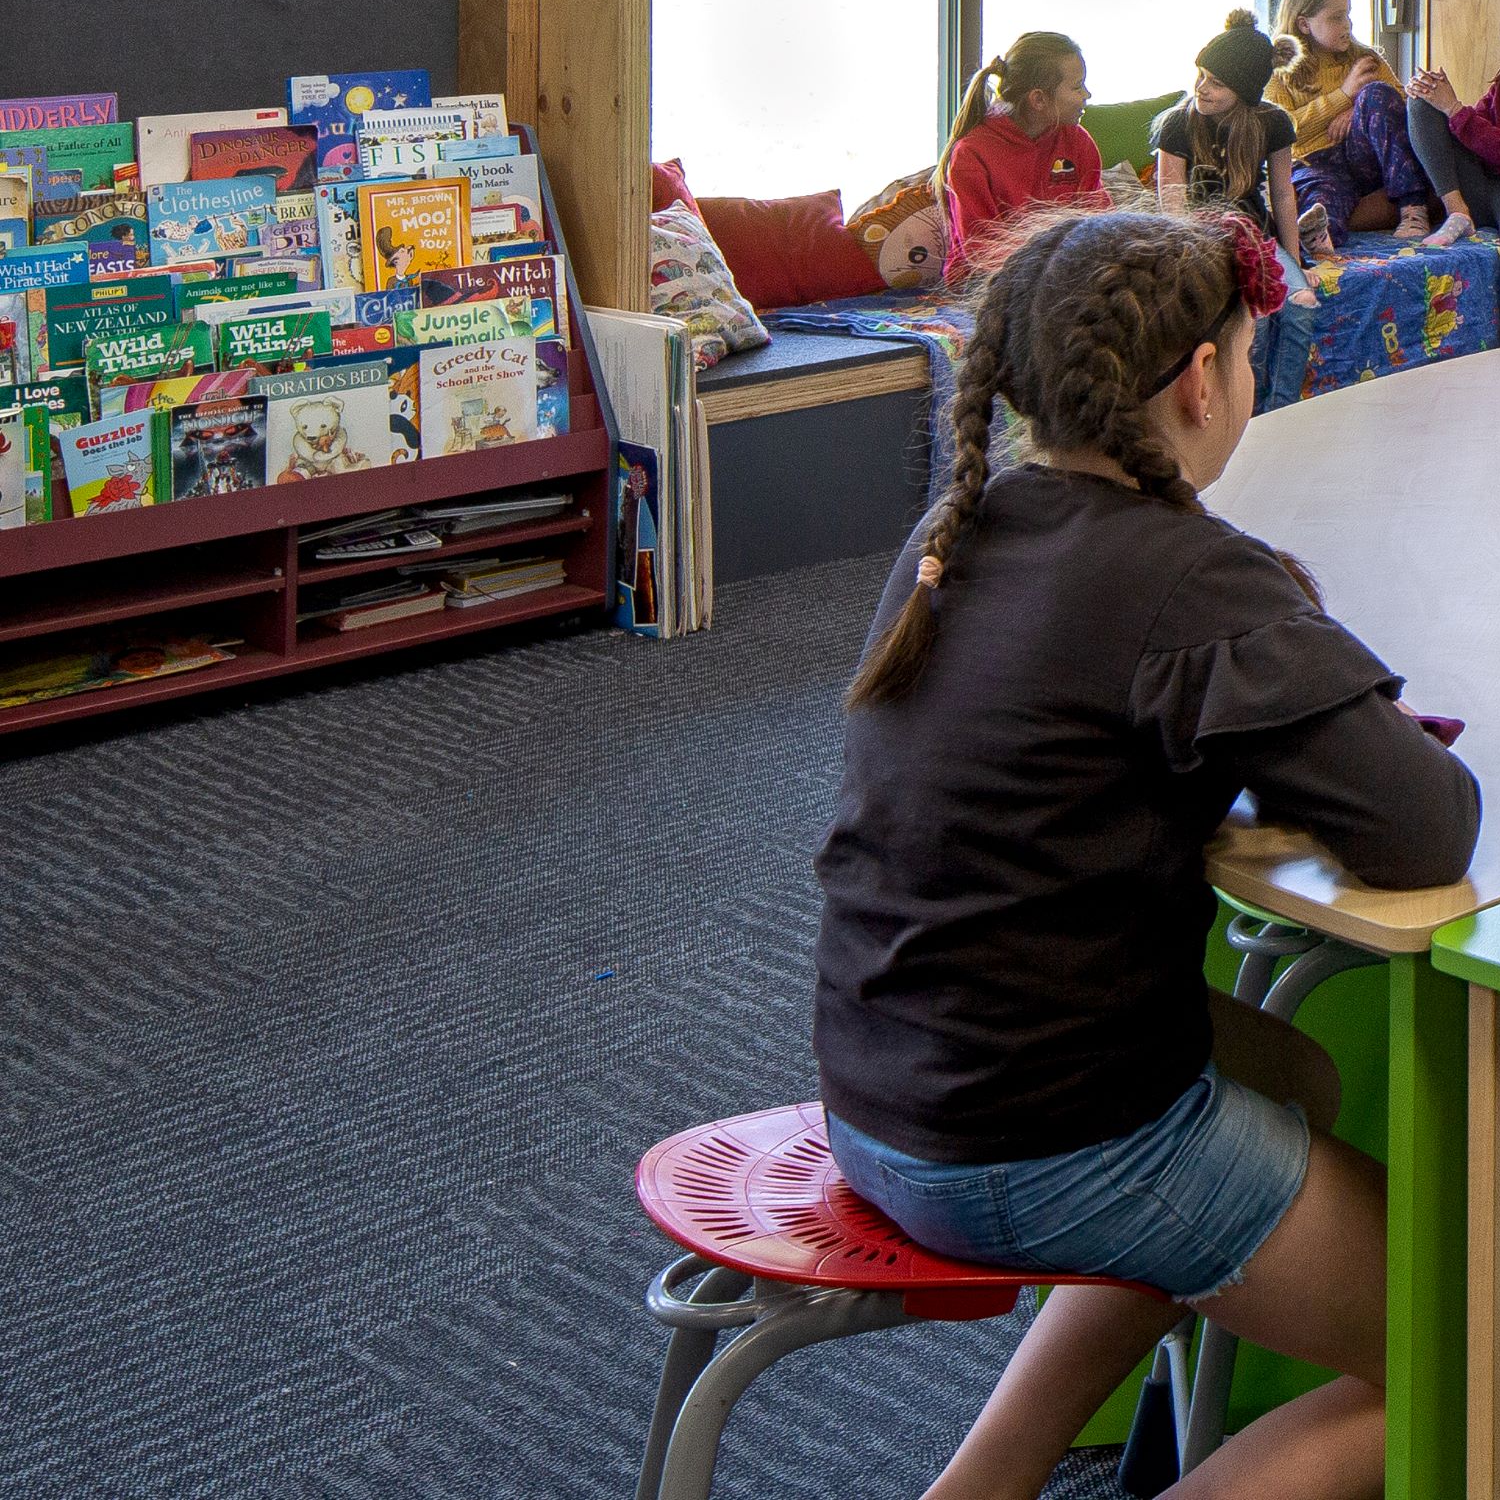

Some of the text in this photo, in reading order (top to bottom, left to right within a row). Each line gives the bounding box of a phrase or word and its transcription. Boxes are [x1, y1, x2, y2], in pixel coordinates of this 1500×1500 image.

[479, 100, 499, 110] Likes
[58, 137, 122, 152] Father of All
[199, 132, 281, 160] DINOSAUR
[238, 139, 309, 164] DANGER
[458, 163, 514, 180] My book
[175, 186, 193, 196] The
[485, 179, 510, 187] Maris
[158, 183, 265, 216] Clothesline
[386, 192, 453, 208] MR. BROWN
[63, 202, 117, 236] GOING
[391, 206, 415, 218] CAN
[401, 207, 453, 232] MOO!
[423, 228, 448, 238] CAN
[419, 237, 453, 251] YOU?
[0, 263, 32, 277] Wish
[43, 258, 72, 272] Had
[454, 260, 551, 290] The Witch
[4, 272, 69, 290] Pirate Suit
[185, 286, 222, 298] Animals
[224, 283, 239, 293] are
[241, 280, 256, 291] not
[258, 278, 273, 289] like
[276, 279, 287, 288] us
[95, 288, 125, 297] PHILIP'S
[506, 285, 537, 298] With
[82, 303, 139, 318] ATLAS OF
[361, 291, 420, 326] Charl
[54, 311, 168, 336] NEW ZEALAND
[420, 306, 492, 332] Jungle
[230, 320, 287, 341] Wild
[96, 332, 165, 359] Wild
[229, 333, 315, 357] Things
[331, 338, 347, 347] The
[98, 345, 195, 374] Things
[432, 346, 530, 376] Greedy Cat
[464, 363, 496, 375] and the
[260, 368, 382, 398] HORATIO'S BED
[436, 368, 526, 390] School Pet Show
[16, 386, 60, 400] I Love
[75, 422, 145, 451] Guzzler
[82, 444, 108, 458] Does
[108, 439, 125, 451] the
[126, 433, 143, 446] Job
